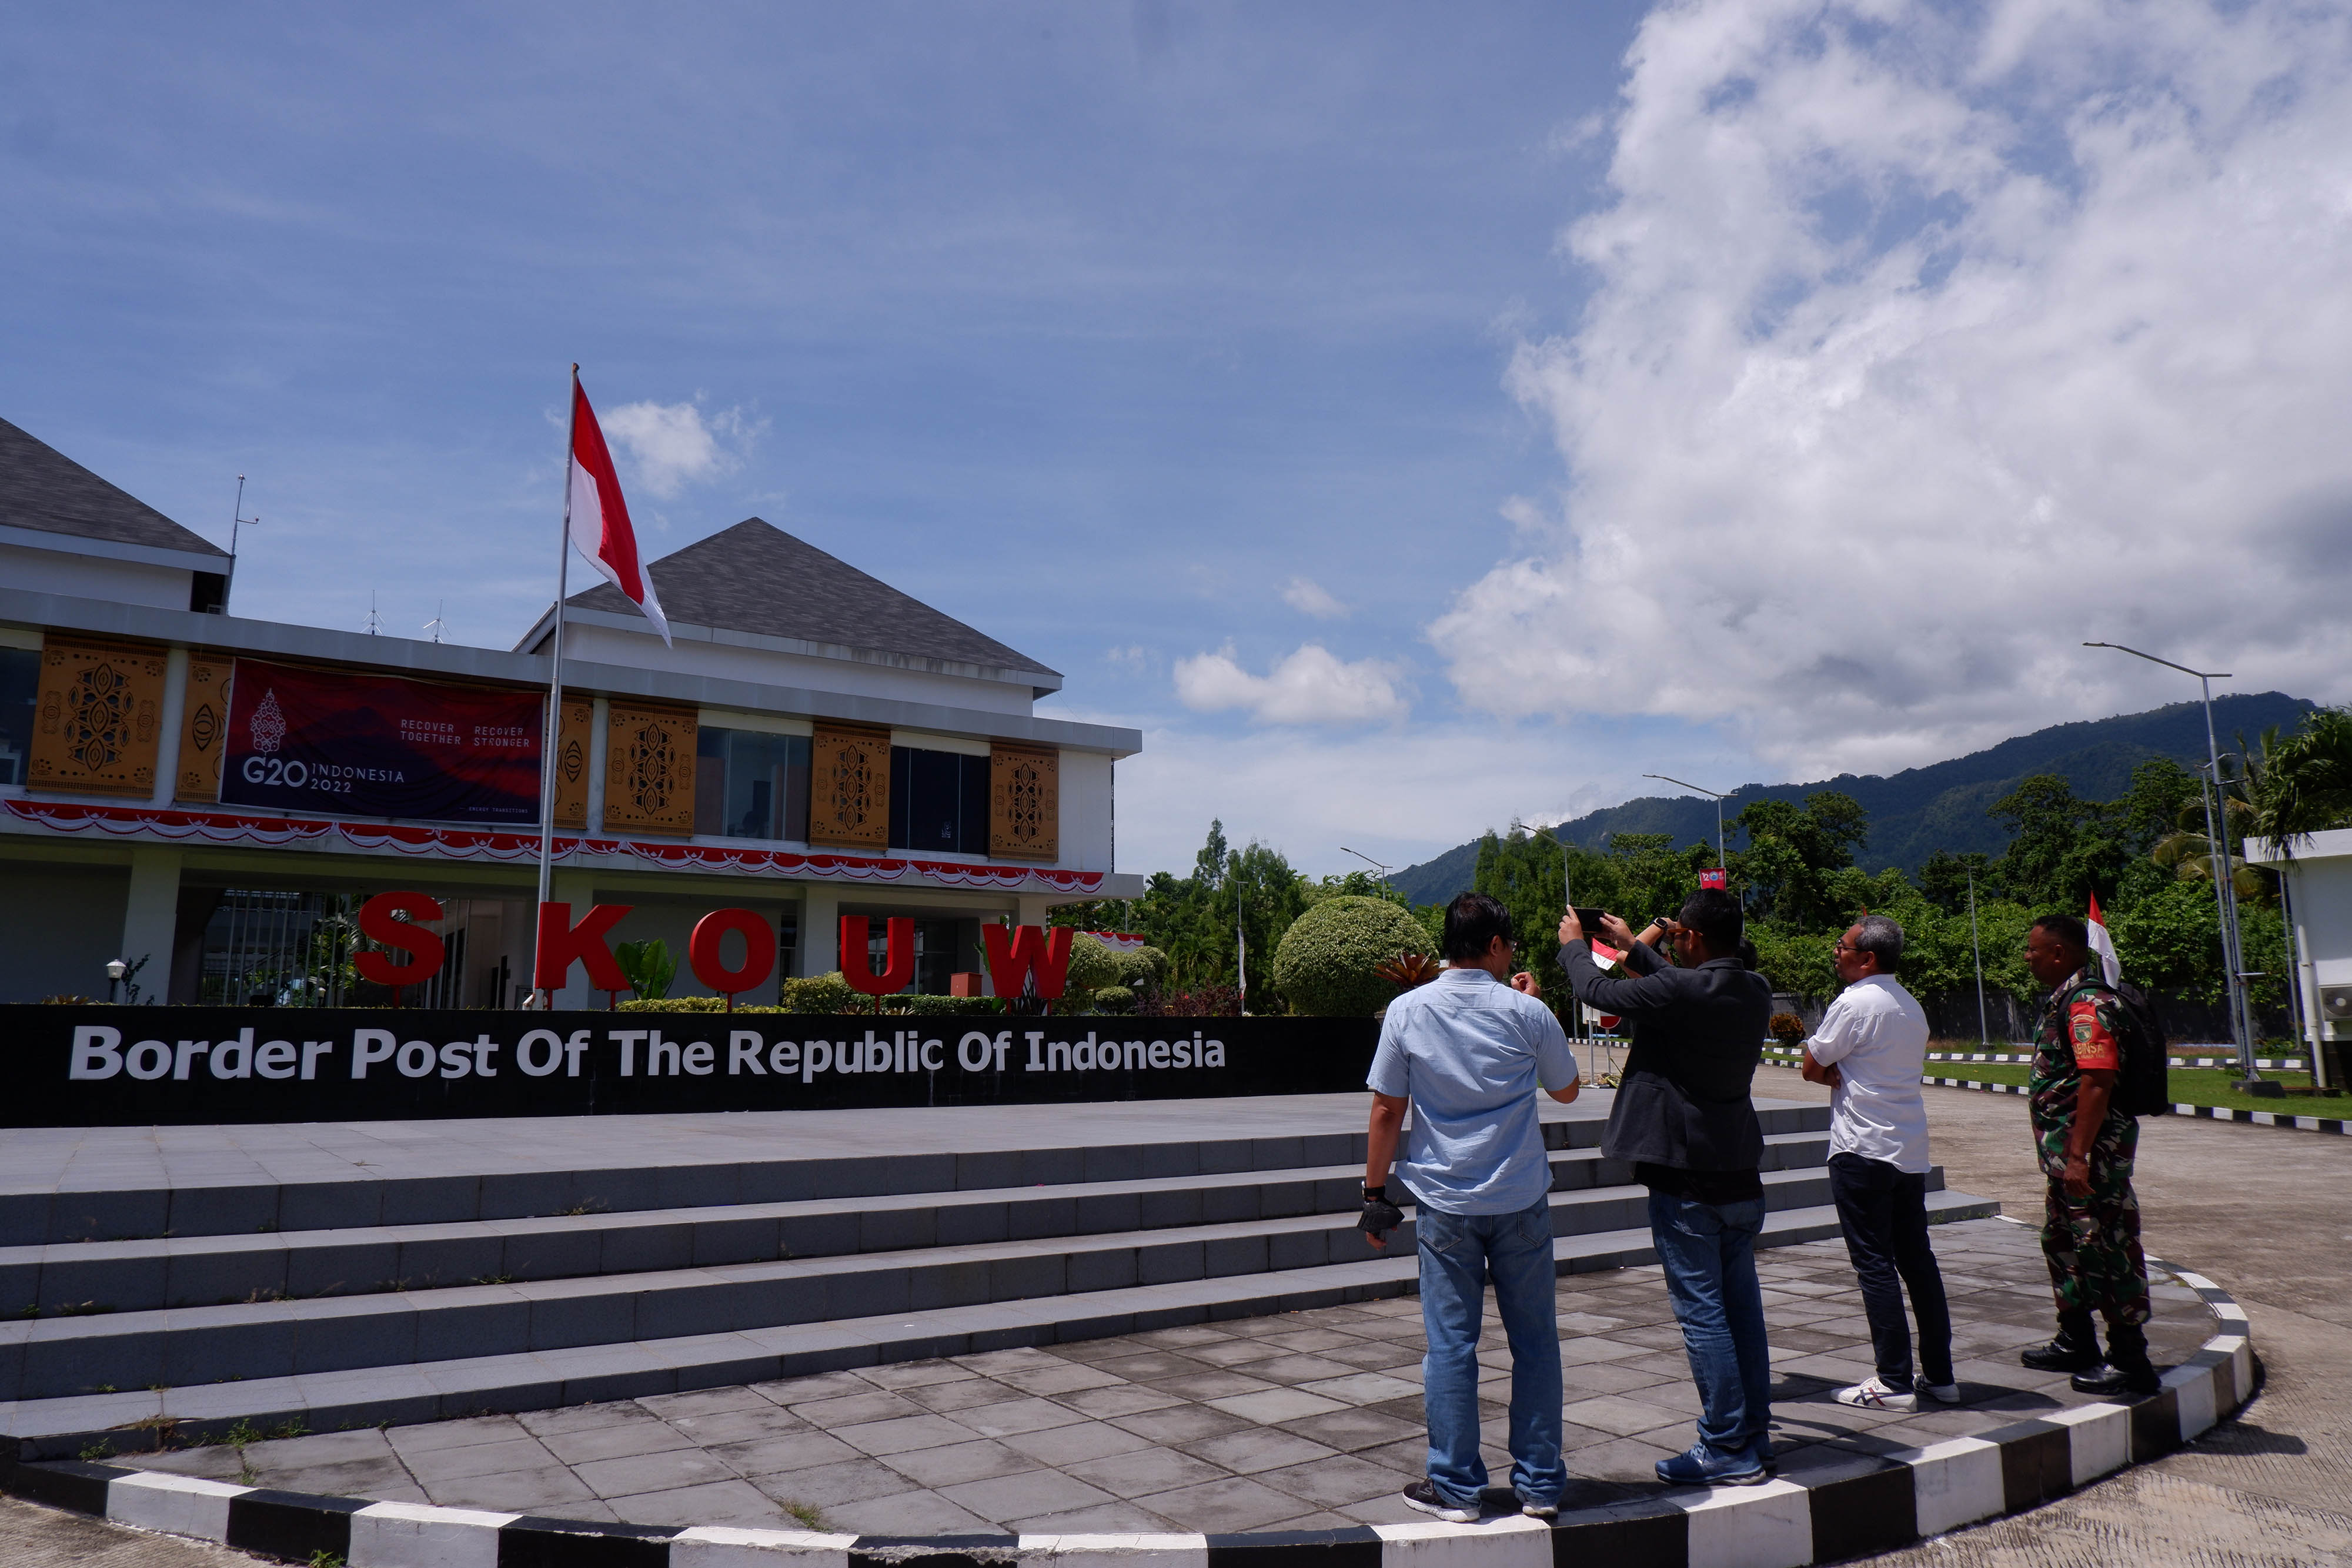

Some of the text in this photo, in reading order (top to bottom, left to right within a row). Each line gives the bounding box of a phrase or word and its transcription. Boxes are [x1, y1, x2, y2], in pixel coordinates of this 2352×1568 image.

[401, 719, 454, 733] RECOVER
[475, 726, 523, 736] RECOVER
[400, 731, 461, 745] TOGETHER
[474, 737, 530, 747] STRONGER
[243, 756, 308, 788] G20
[311, 763, 405, 783] INDONESIA
[310, 778, 351, 793] 2022
[353, 891, 1075, 999] SKOUW
[69, 1025, 1225, 1084] Border Post Of The Republic Of Indonesia
